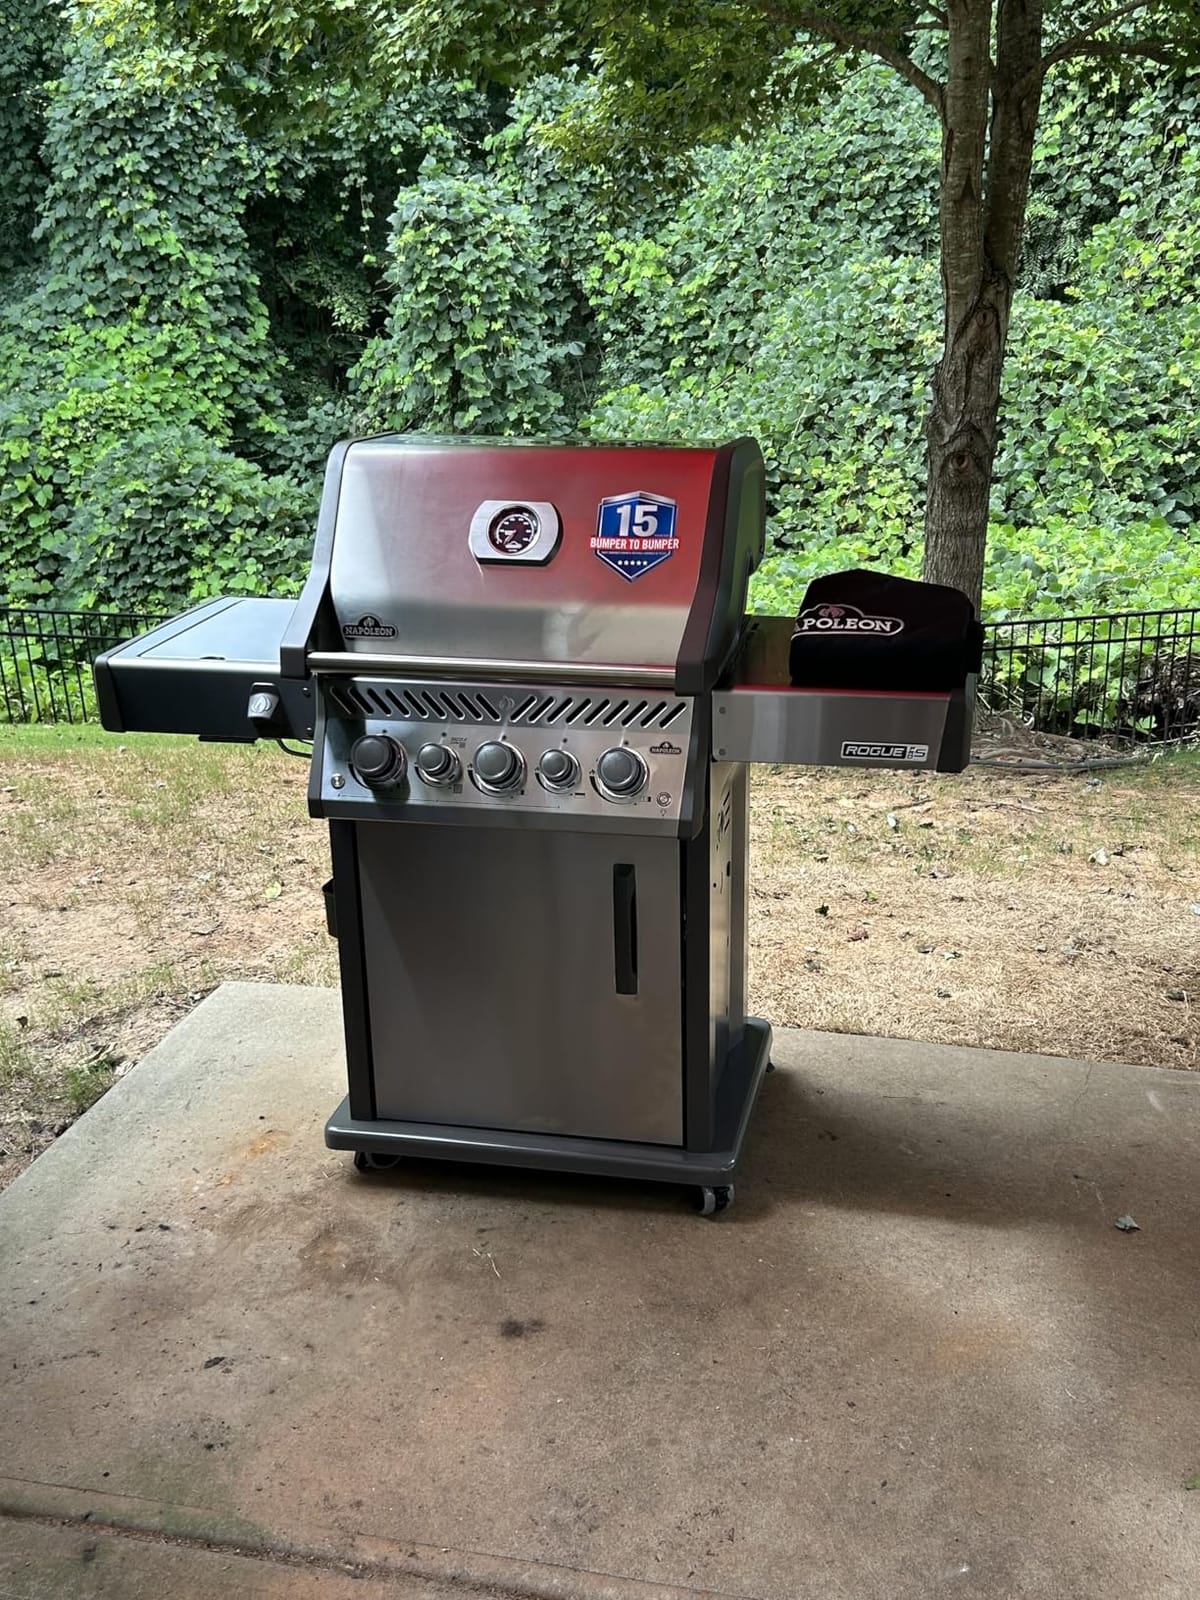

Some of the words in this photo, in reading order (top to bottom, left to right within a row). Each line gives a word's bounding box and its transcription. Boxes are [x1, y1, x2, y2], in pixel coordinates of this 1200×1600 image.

[616, 504, 658, 537] 15
[590, 537, 627, 550] BUMPER
[629, 539, 640, 550] TO
[642, 538, 680, 550] BUMPER
[344, 626, 393, 636] NAPOLEON
[845, 745, 905, 757] ROGUE
